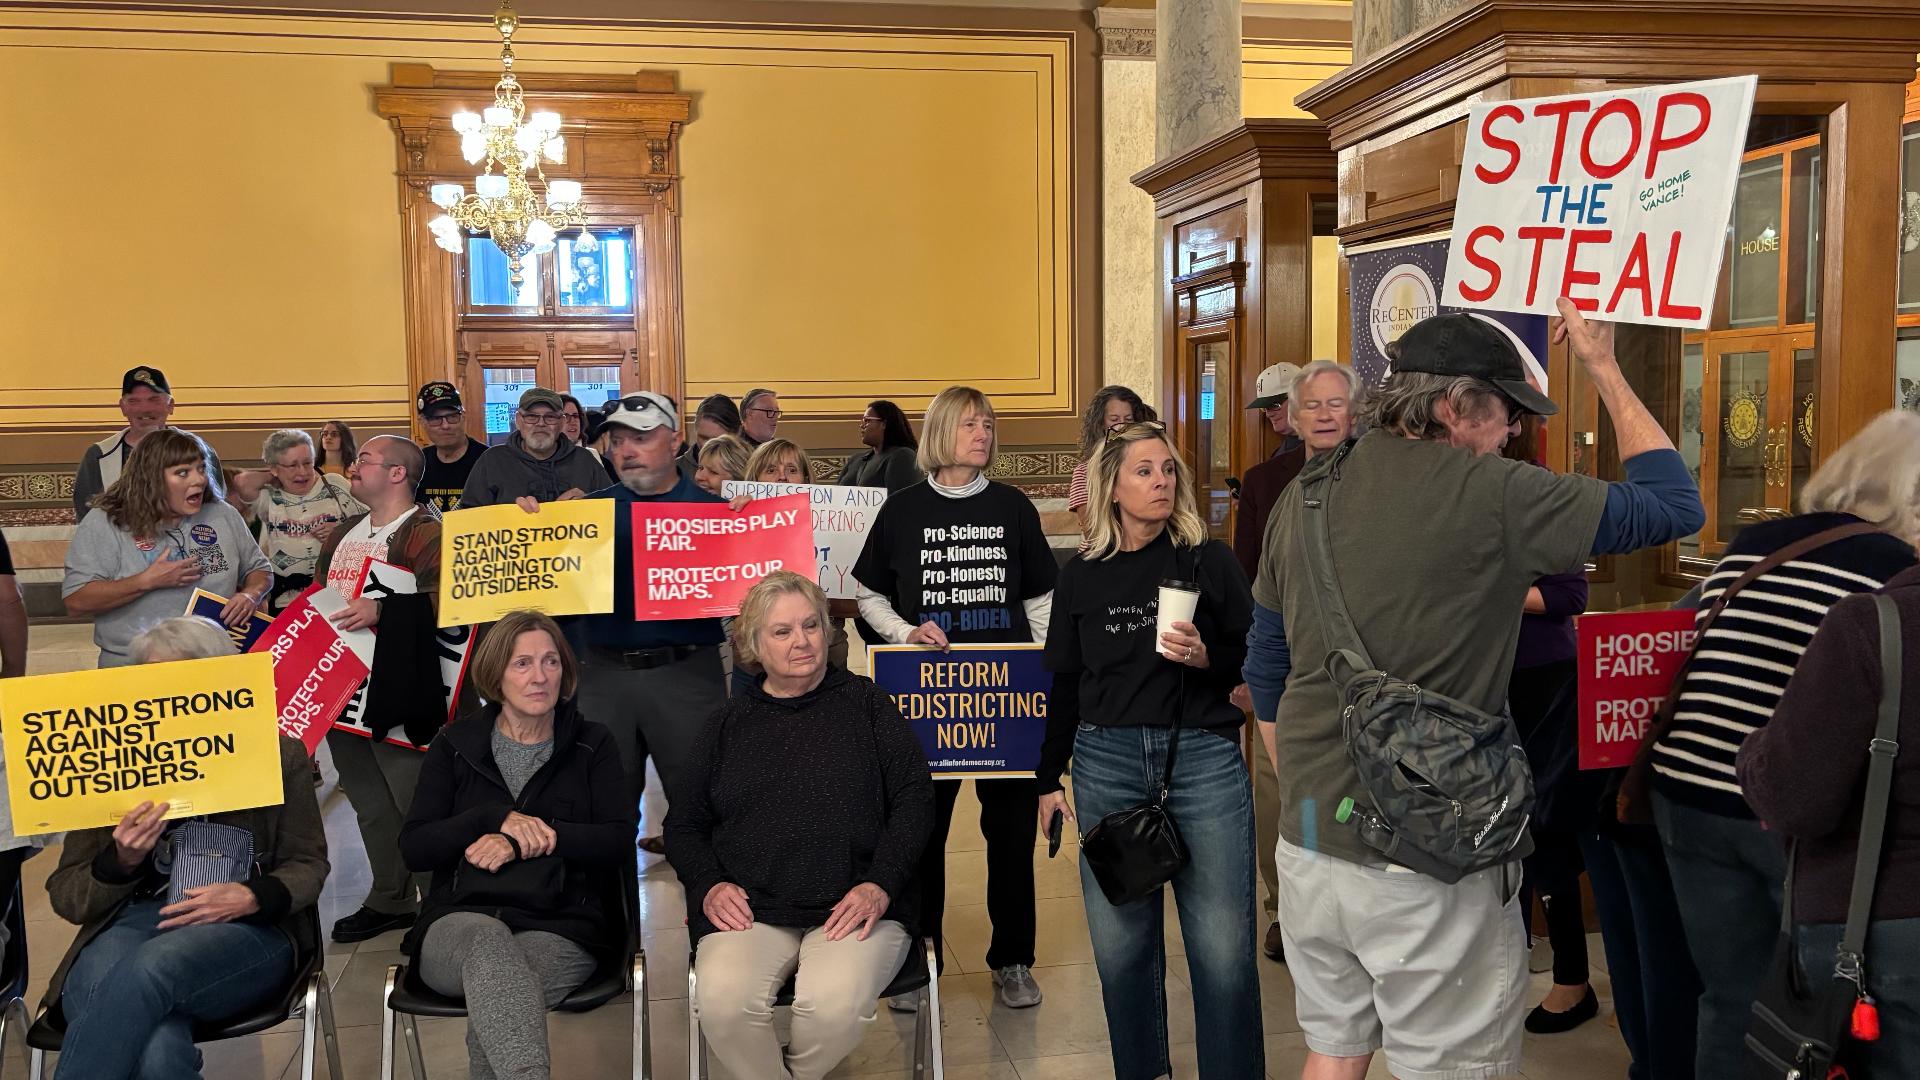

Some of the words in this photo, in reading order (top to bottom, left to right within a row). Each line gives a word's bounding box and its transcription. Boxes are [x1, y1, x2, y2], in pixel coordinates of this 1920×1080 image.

[1475, 92, 1711, 184] STOP
[1640, 187, 1654, 201] GO
[1658, 169, 1691, 192] HOME
[1642, 184, 1684, 211] VANCE!
[1536, 183, 1613, 224] THE
[1741, 236, 1779, 255] HOUSE
[1458, 225, 1701, 320] STEAL
[588, 383, 603, 391] 301
[845, 488, 884, 507] AND
[646, 517, 747, 535] HOOSIERS
[750, 509, 798, 531] PLAY
[811, 509, 865, 533] DERING
[923, 524, 1004, 543] Pro-Science
[453, 529, 513, 550] STAND
[516, 524, 598, 543] STRONG
[646, 534, 696, 551] FAIR.
[453, 543, 533, 567] AGAINST
[920, 546, 1008, 566] Pro-Kindness
[453, 556, 581, 583] WASHINGTON
[648, 565, 737, 584] PROTECT
[741, 559, 784, 580] OUR
[922, 565, 1006, 585] Pro-Honesty
[451, 574, 558, 600] OUTSIDERS.
[648, 583, 713, 600] MAPS.
[922, 586, 1007, 606] Pro-Equality
[1108, 606, 1143, 616] WOMEN
[1595, 630, 1698, 657] HOOSIE
[920, 661, 1009, 688] REFORM
[1595, 655, 1660, 679] FAIR.
[277, 668, 324, 732] ROTECT
[318, 637, 346, 672] OUR
[23, 704, 128, 734] STAND
[133, 688, 254, 721] STRONG
[888, 692, 1047, 720] EDISTRICTING
[1596, 696, 1667, 722] PROT
[25, 721, 160, 757] AGAINST
[937, 722, 996, 749] NOW!
[1596, 719, 1652, 744] MAP
[26, 734, 235, 778] WASHINGTON
[29, 760, 205, 800] OUTSIDERS.
